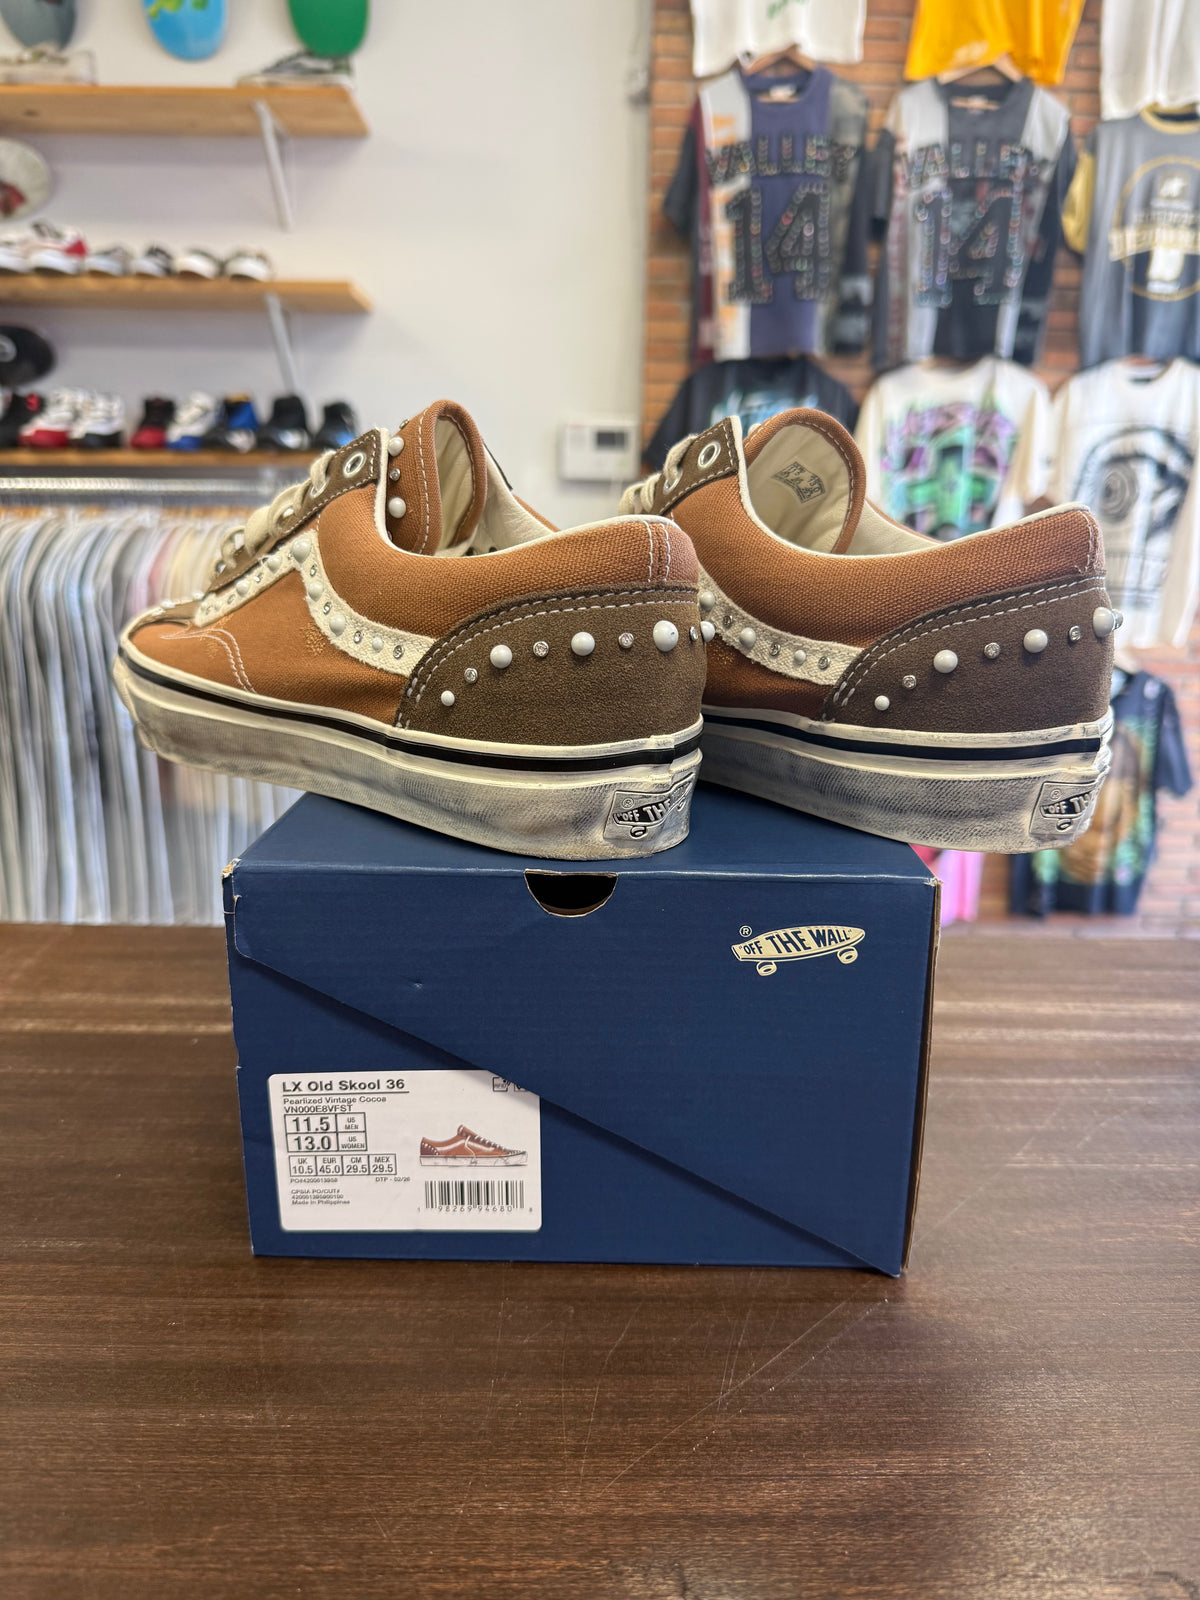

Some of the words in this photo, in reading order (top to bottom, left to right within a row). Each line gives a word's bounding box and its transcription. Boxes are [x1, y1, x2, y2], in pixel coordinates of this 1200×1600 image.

[726, 182, 831, 303] 14
[915, 186, 1023, 309] 14
[765, 930, 811, 954] THE
[282, 1081, 302, 1092] LX
[308, 1080, 332, 1091] Old
[339, 1079, 380, 1091] Skool
[386, 1079, 405, 1090] 36
[284, 1097, 322, 1105] Pearlized
[326, 1096, 356, 1104] Vintage
[284, 1104, 353, 1114] VN000E8VFST
[292, 1116, 330, 1132] 11.5
[294, 1136, 332, 1150] 13.0
[292, 1166, 313, 1174] 10.5
[319, 1165, 340, 1174] 45.0
[346, 1164, 367, 1174] 29.5
[372, 1164, 393, 1173] 29.5
